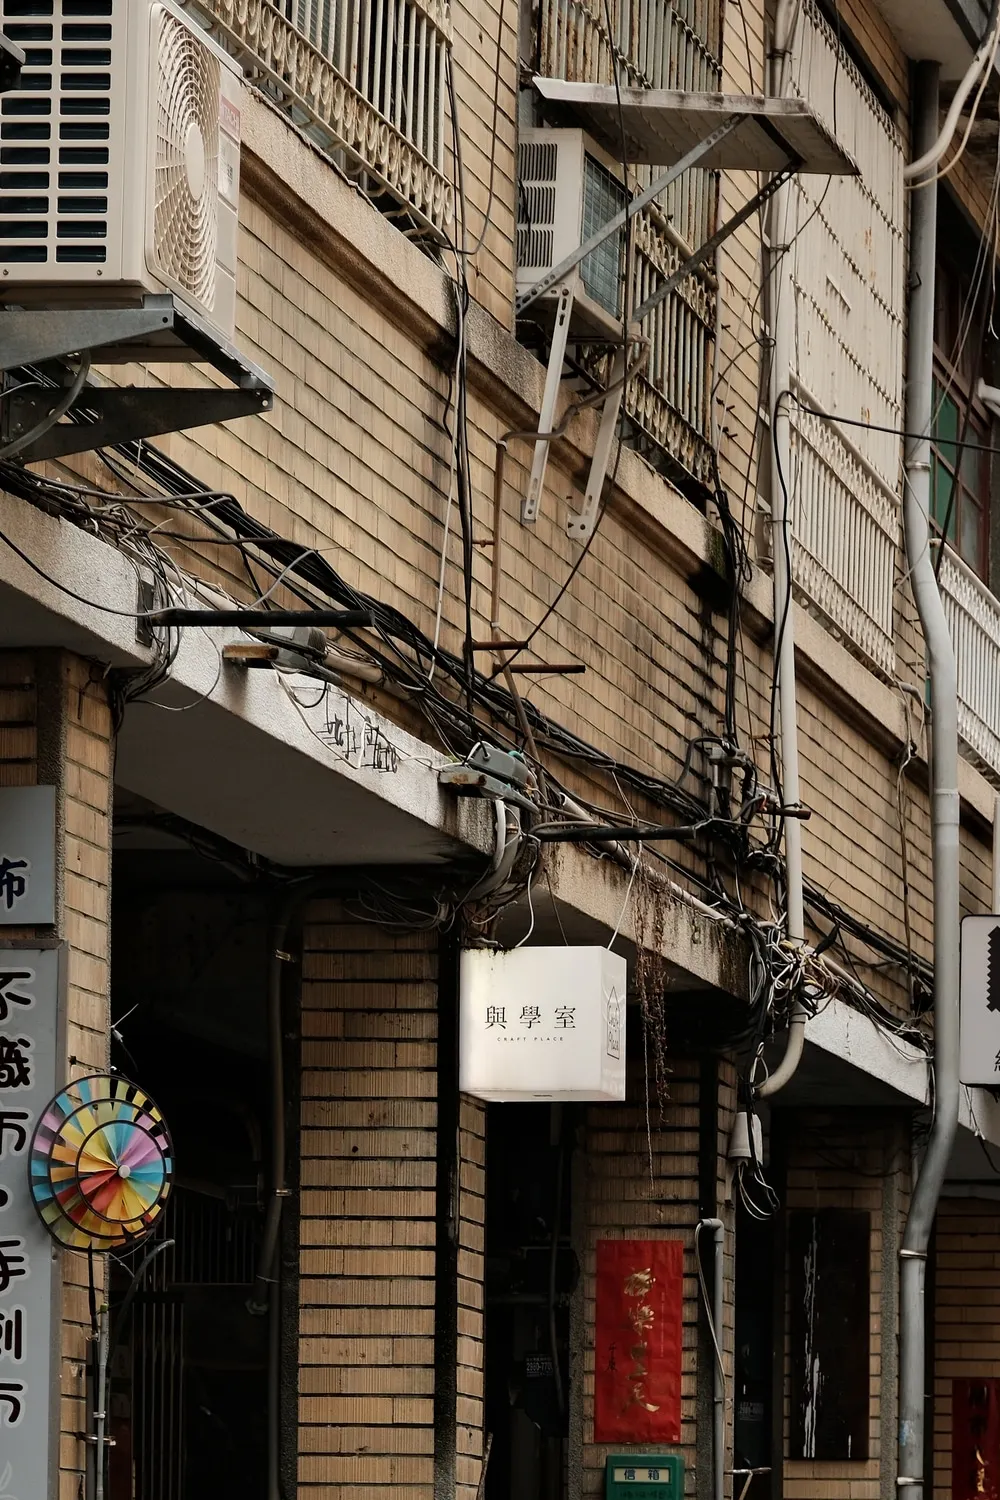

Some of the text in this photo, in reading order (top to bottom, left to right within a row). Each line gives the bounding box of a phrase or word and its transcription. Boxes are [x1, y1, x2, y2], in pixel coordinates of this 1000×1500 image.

[484, 1005, 576, 1029] 與學室
[624, 1468, 660, 1481] 信箱
